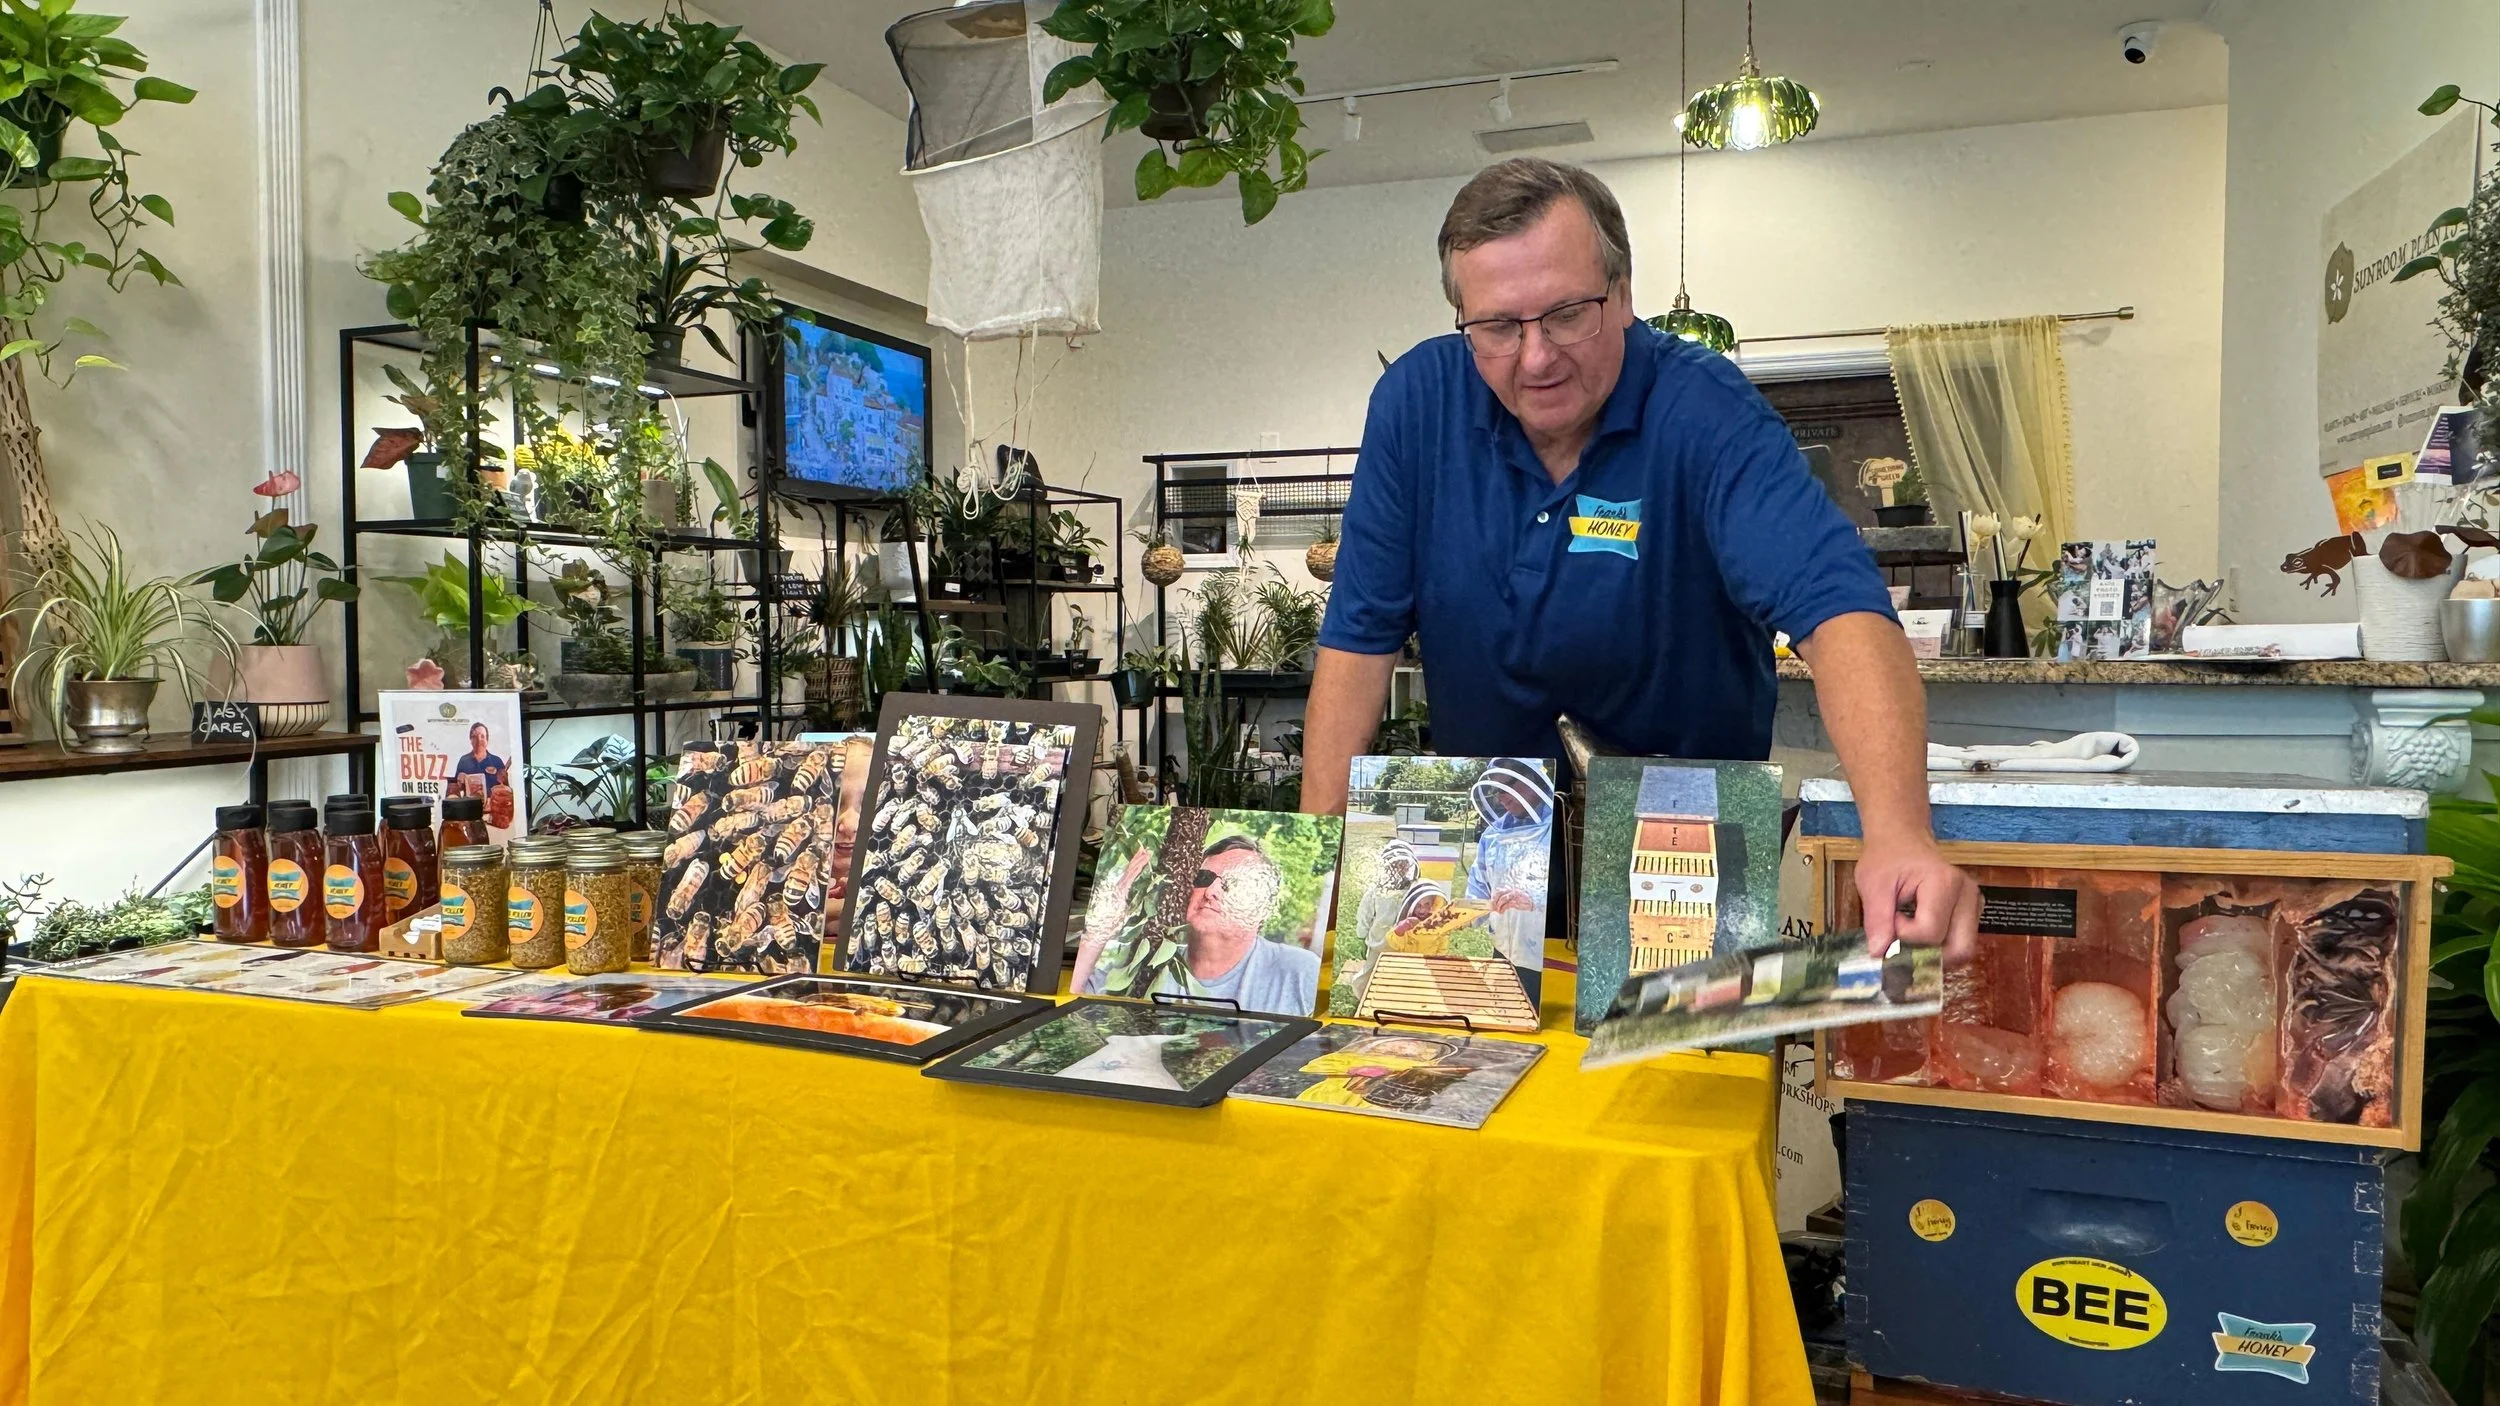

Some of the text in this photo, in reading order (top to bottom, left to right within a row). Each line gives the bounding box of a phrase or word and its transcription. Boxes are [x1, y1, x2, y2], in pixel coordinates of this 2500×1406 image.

[2354, 243, 2408, 294] SUNROOM
[1587, 520, 1634, 537] HONEY
[203, 706, 249, 719] ASY
[199, 722, 244, 733] CARE
[398, 736, 423, 752] THE
[400, 754, 448, 780] BUZZ
[402, 781, 439, 794] ON BEES
[2032, 1276, 2150, 1332] BEE
[2237, 1340, 2294, 1358] HONEY
